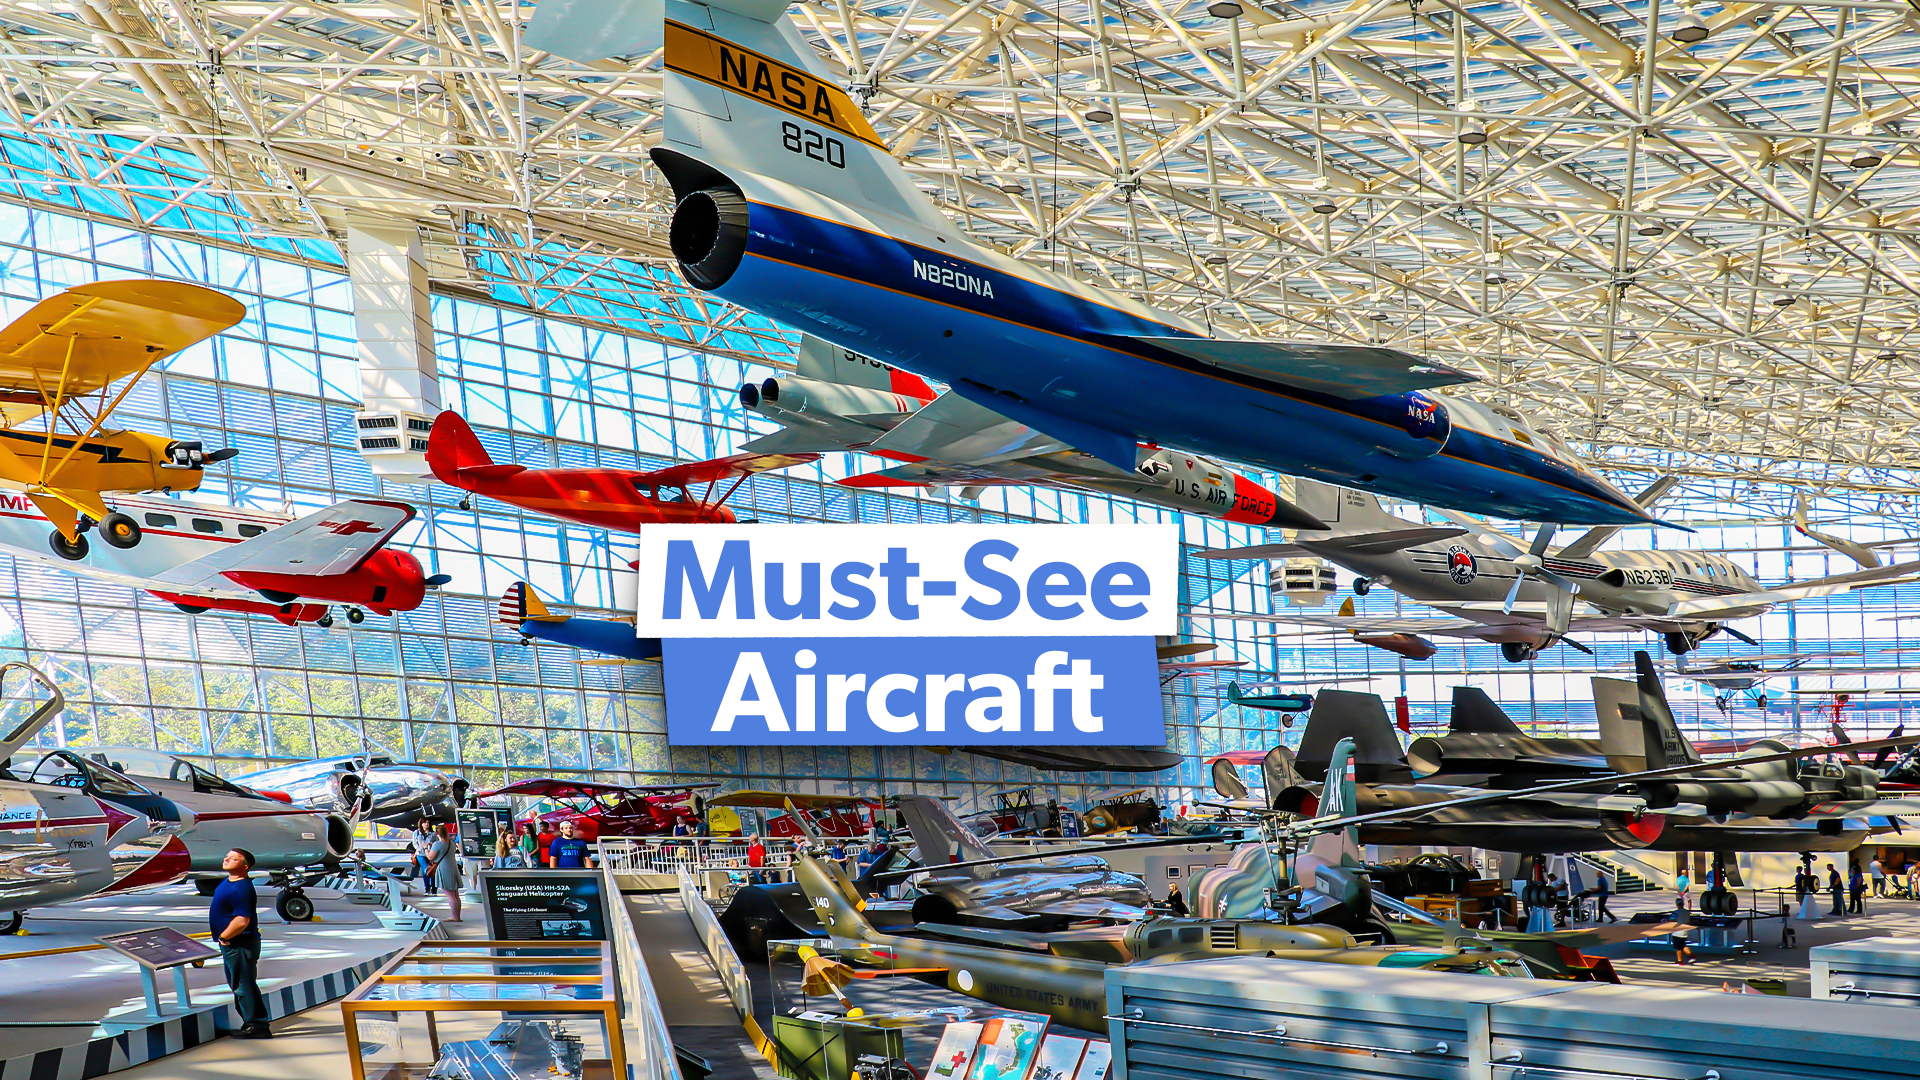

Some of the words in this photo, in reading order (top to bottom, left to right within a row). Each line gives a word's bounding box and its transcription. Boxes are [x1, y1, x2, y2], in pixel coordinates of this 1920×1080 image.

[719, 45, 836, 124] NASA
[781, 120, 846, 170] 820
[913, 259, 995, 300] N820NA
[1408, 404, 1436, 425] NASA
[1205, 487, 1228, 506] AIR
[1231, 493, 1274, 518] FORCE
[1664, 742, 1680, 752] ARMY
[986, 982, 1023, 999] UNITED
[1025, 989, 1065, 1007] STATES
[1068, 996, 1098, 1012] ARMY
